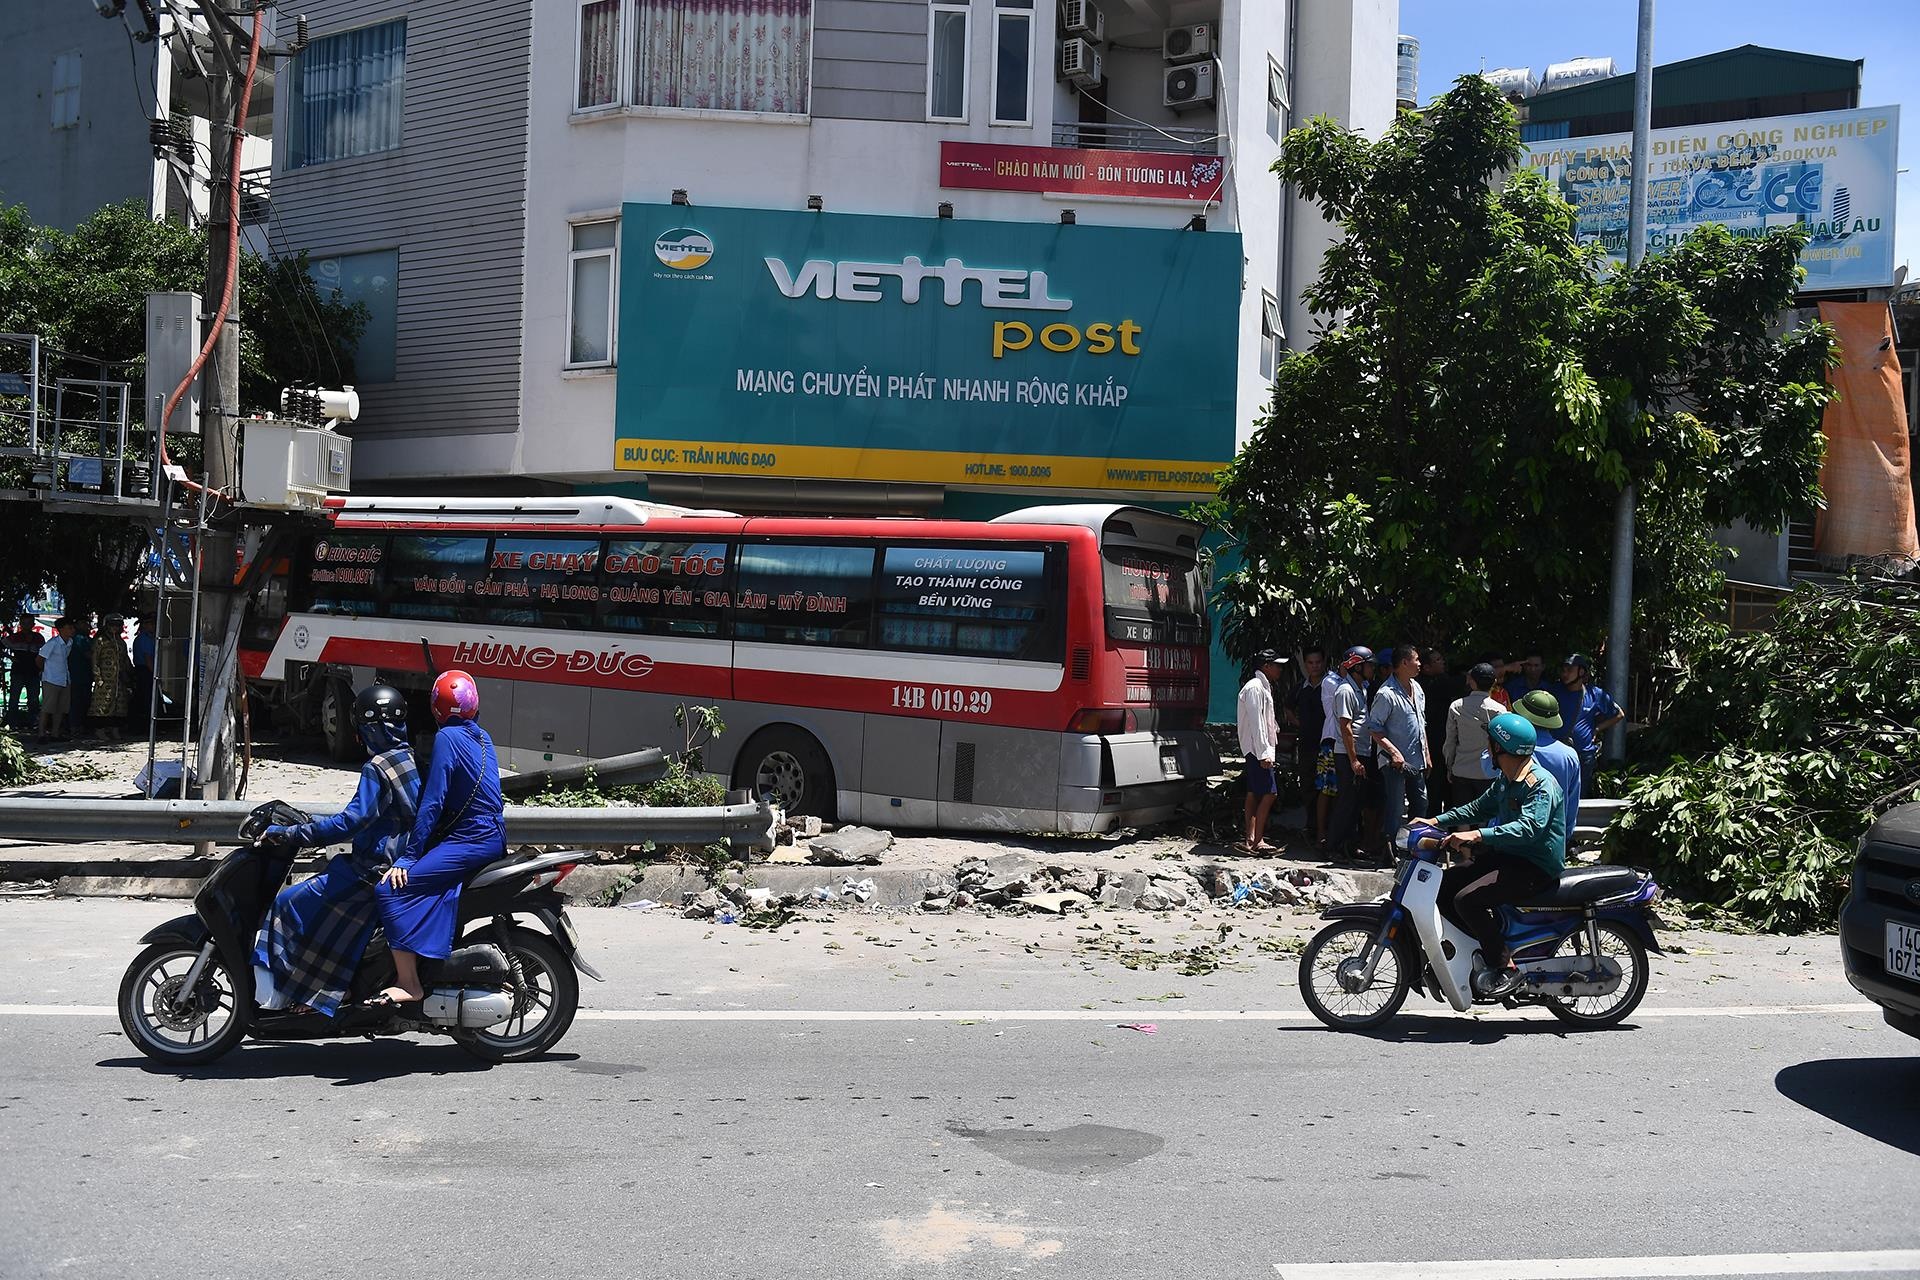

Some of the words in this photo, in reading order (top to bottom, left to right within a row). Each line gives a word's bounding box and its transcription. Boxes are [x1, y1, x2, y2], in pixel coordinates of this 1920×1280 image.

[1530, 148, 1577, 166] MÁY
[1585, 142, 1632, 163] PHÁ
[1717, 129, 1784, 149] CÔNG
[1793, 116, 1888, 141] NGHIỆP
[997, 159, 1029, 177] CHÀO
[1032, 161, 1059, 179] NĂM
[1063, 162, 1086, 180] MỚI
[1097, 164, 1122, 182] ĐÓN
[1125, 167, 1164, 184] TƯƠNG
[1565, 164, 1610, 182] CÔNG
[1614, 161, 1655, 178] SUT
[1757, 145, 1838, 165] 2.500KVA
[1579, 181, 1681, 207] SBMPWER
[1852, 216, 1881, 232] ÂU
[656, 243, 712, 253] VIETTEL
[764, 255, 1073, 311] VIETTEL
[993, 319, 1142, 358] post
[736, 369, 795, 396] MẠNG
[802, 365, 881, 397] CHUYỂN
[887, 371, 937, 400] PHÁT
[943, 378, 1010, 402] NHANH
[1016, 376, 1069, 407] RỘNG
[1074, 376, 1128, 407] KHẮP
[623, 447, 648, 462] BƯU
[651, 448, 679, 465] CỤC:
[682, 445, 713, 465] TRẦN
[716, 450, 749, 466] HƯNG
[751, 453, 776, 469] ĐẠO
[965, 463, 1006, 477] HOTLINE:
[327, 543, 358, 562] HÙNG
[357, 544, 382, 563] ĐỨC
[491, 551, 523, 569] XE
[529, 552, 599, 575] CHẠY
[604, 554, 660, 574] CAO
[670, 549, 725, 576] TỐC
[914, 553, 953, 569] CHẤT
[956, 558, 1007, 572] LƯỢNG
[439, 572, 466, 593] ĐỒN
[474, 572, 501, 595] CẨM
[504, 577, 530, 598] PHẢ
[540, 584, 560, 603] HẠ
[561, 585, 599, 601] LONG
[609, 582, 660, 604] QUẢNG
[663, 585, 692, 606] YÊN
[703, 591, 730, 608] GIA
[735, 589, 767, 609] LÂM
[778, 590, 804, 611] MỸ
[806, 591, 847, 613] ĐÌNH
[895, 575, 924, 589] TẠO
[928, 574, 977, 589] THÀNH
[979, 576, 1023, 590] CÔNG
[918, 591, 947, 607] BỀN
[952, 594, 993, 609] VỮNG
[1126, 625, 1137, 639] XE
[453, 633, 557, 670] HÙNG
[566, 643, 655, 678] ĐỨC
[891, 685, 926, 709] 14B
[931, 688, 993, 714] 019.29
